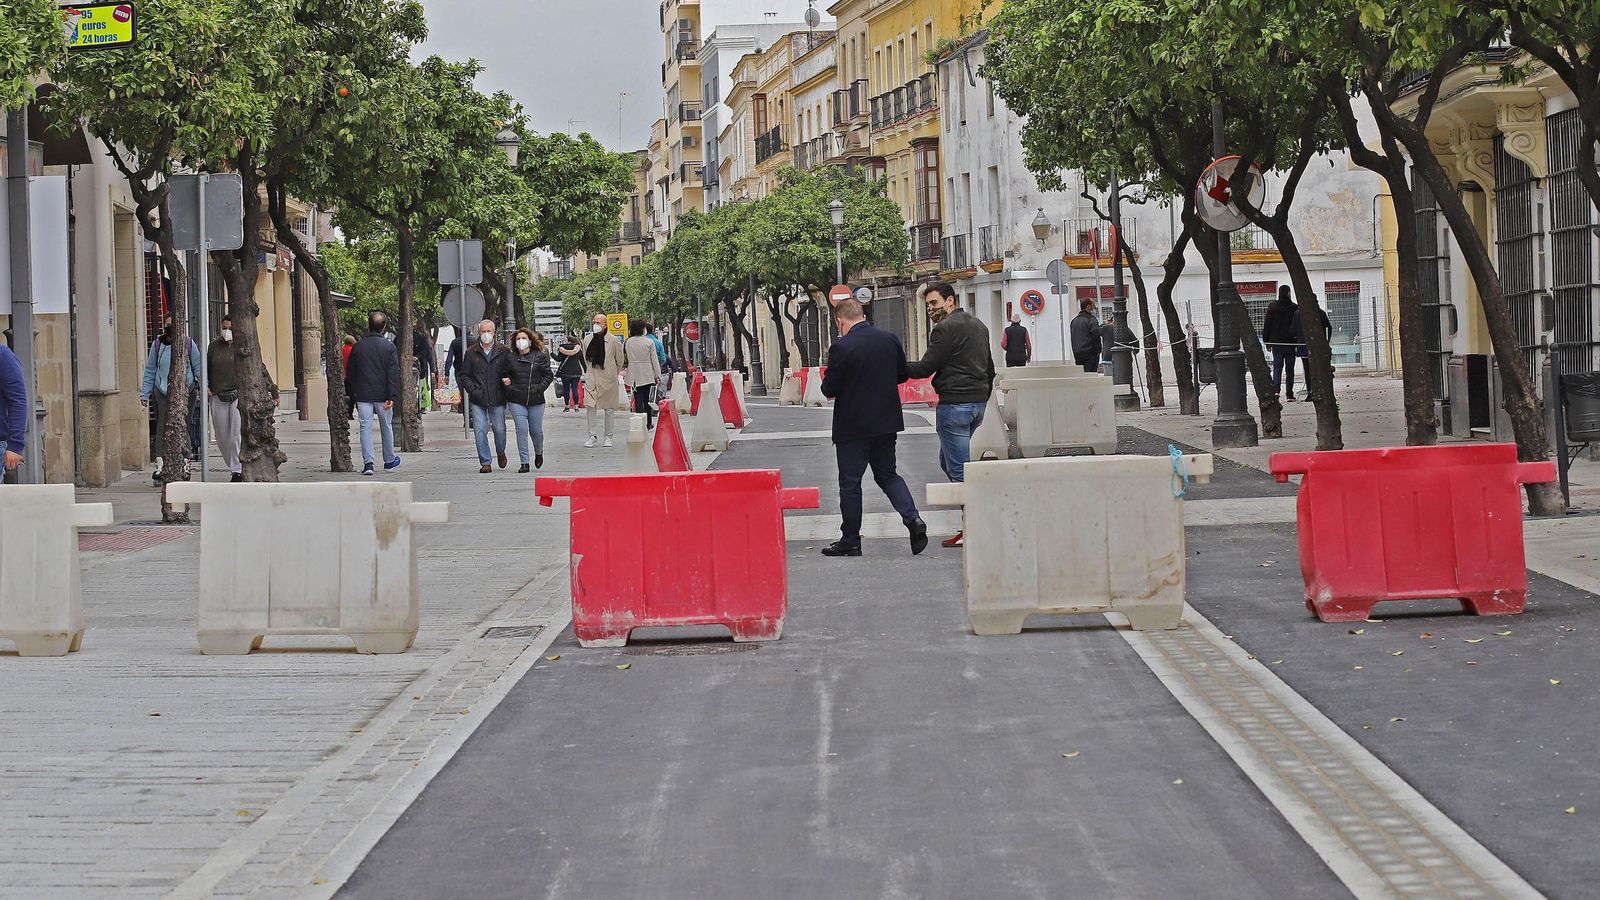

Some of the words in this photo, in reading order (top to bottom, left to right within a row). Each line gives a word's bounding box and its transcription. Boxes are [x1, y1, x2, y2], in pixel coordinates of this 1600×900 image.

[81, 10, 92, 18] 95
[82, 22, 106, 30] euros
[82, 35, 92, 43] 24
[94, 34, 117, 42] horas
